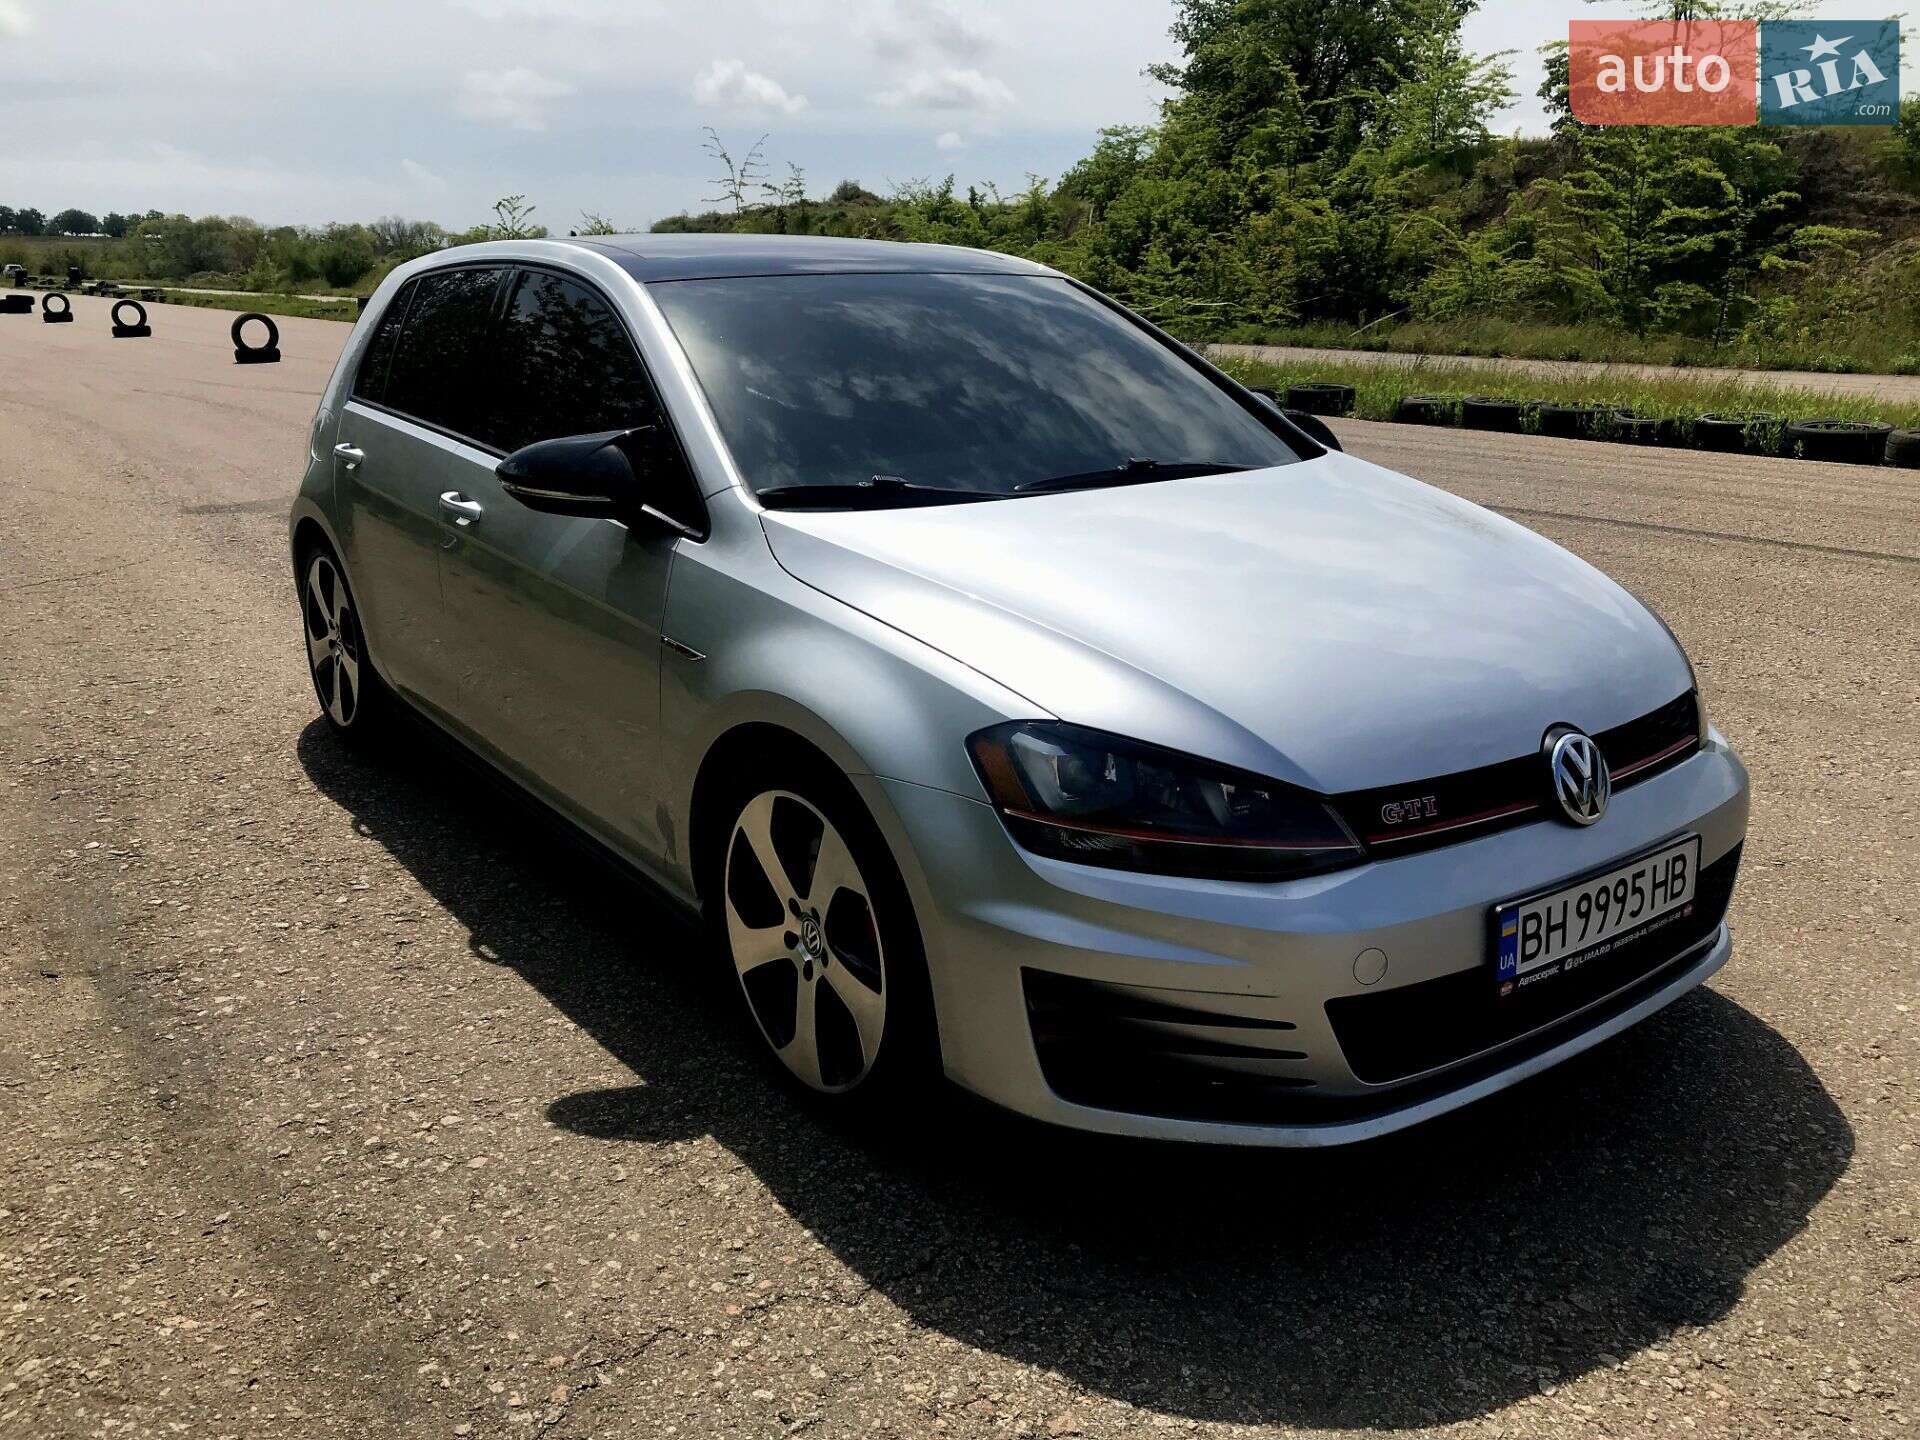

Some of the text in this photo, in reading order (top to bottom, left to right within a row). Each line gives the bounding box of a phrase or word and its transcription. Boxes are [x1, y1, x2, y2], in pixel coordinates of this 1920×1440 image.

[1381, 796, 1437, 824] GTI
[1520, 853, 1688, 964] BH 9995 HB
[1500, 952, 1515, 970] UA
